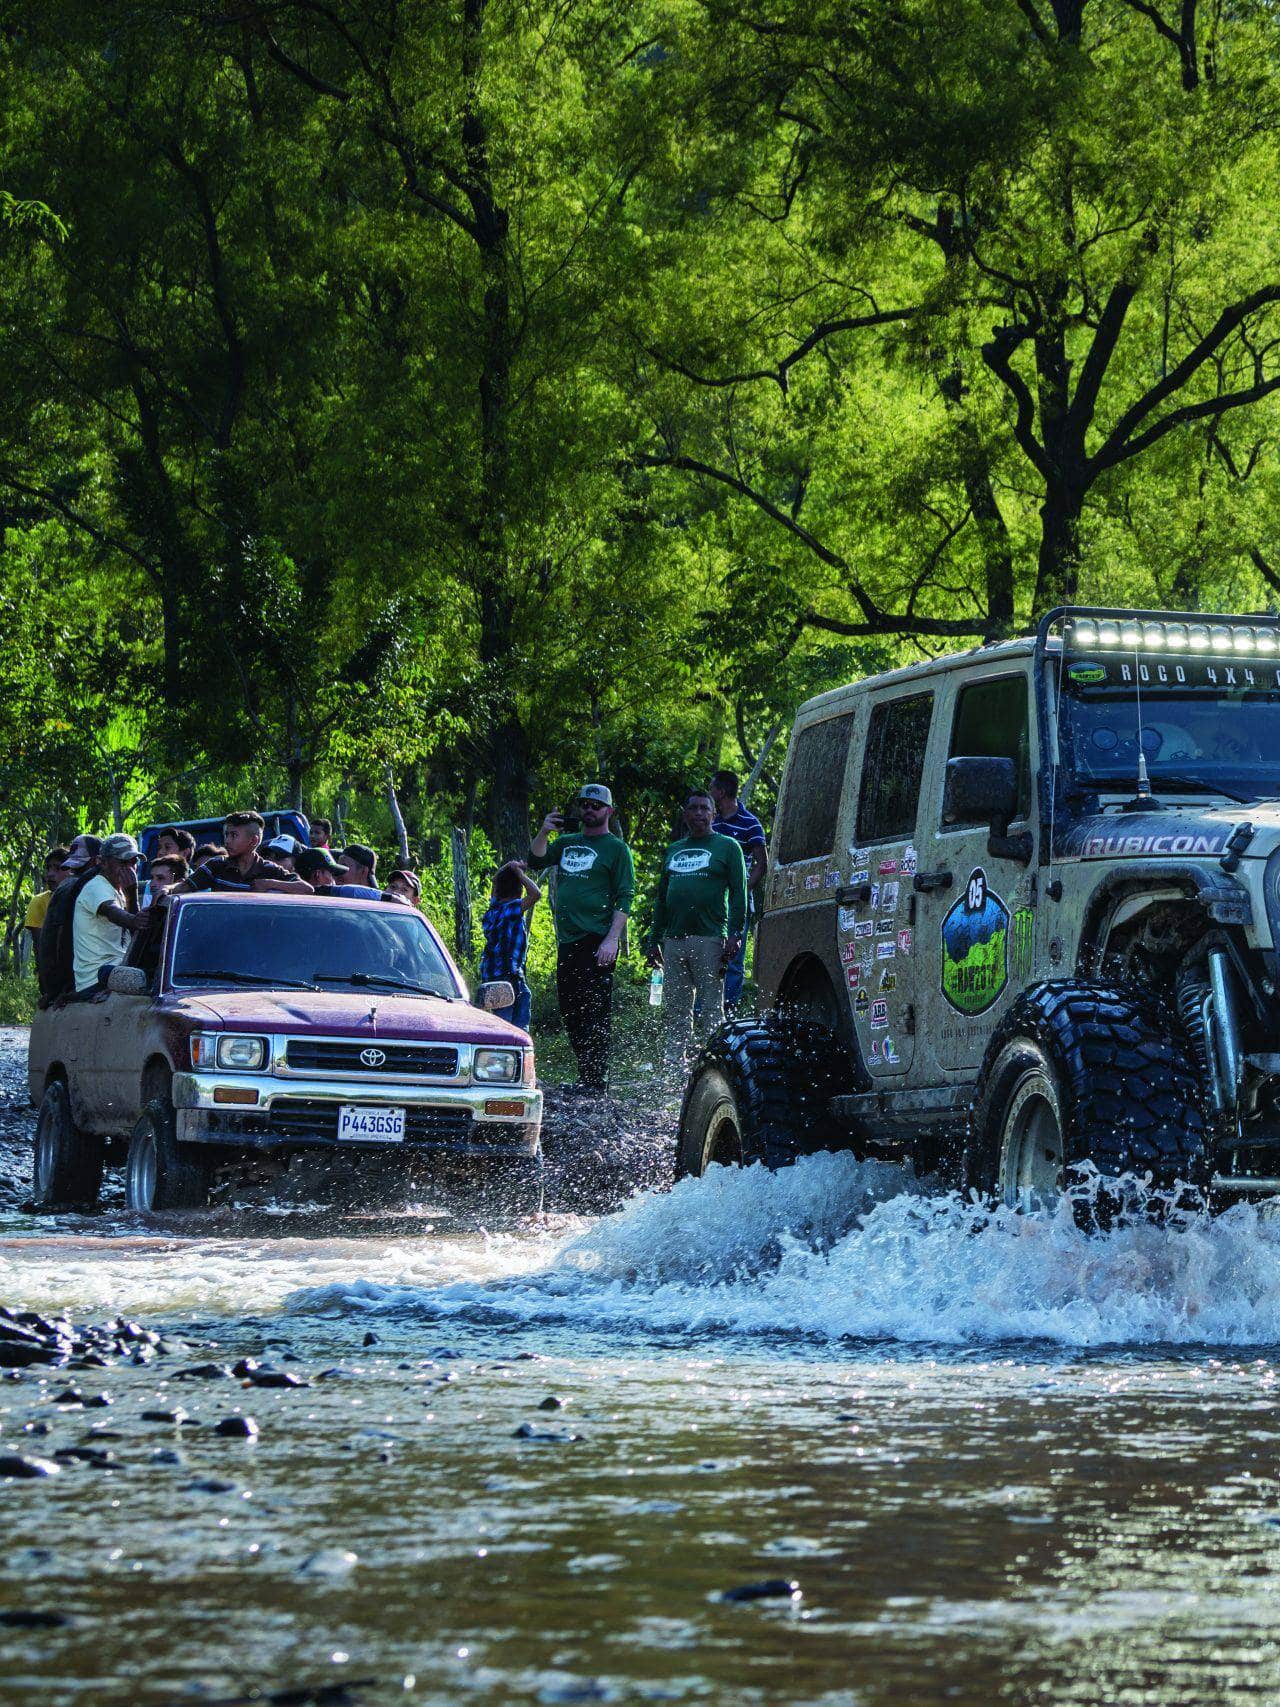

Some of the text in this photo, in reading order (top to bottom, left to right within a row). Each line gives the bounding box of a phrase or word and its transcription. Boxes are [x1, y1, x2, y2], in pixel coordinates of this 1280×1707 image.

[1120, 663, 1185, 682] ROCO
[1206, 666, 1256, 685] 4X4
[1085, 836, 1221, 855] RUBICON
[968, 877, 984, 909] 05
[342, 1114, 402, 1133] P443GSG
